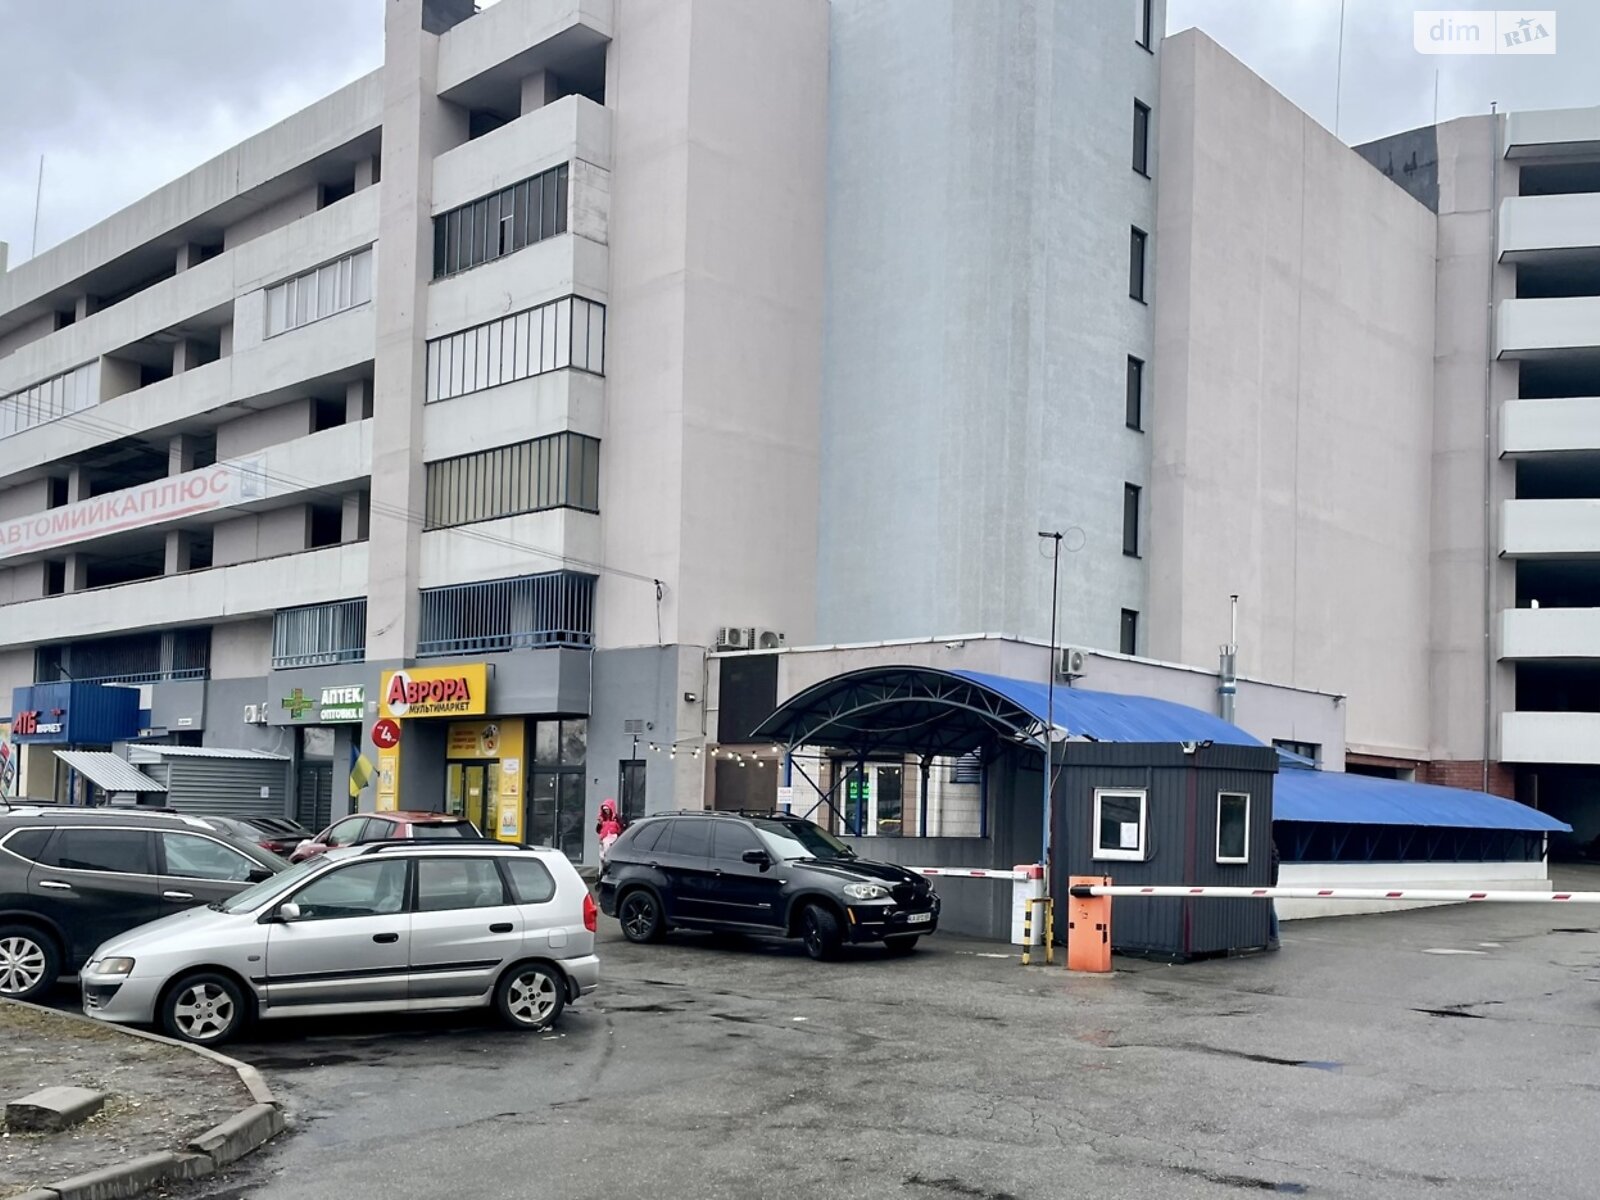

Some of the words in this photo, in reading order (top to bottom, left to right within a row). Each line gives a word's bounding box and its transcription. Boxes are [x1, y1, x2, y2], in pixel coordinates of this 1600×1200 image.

[321, 687, 364, 705] АПТЕК
[408, 702, 470, 714] МУЛЬТИМАРКЕТ
[12, 710, 37, 735] АТБ
[380, 725, 392, 742] 4
